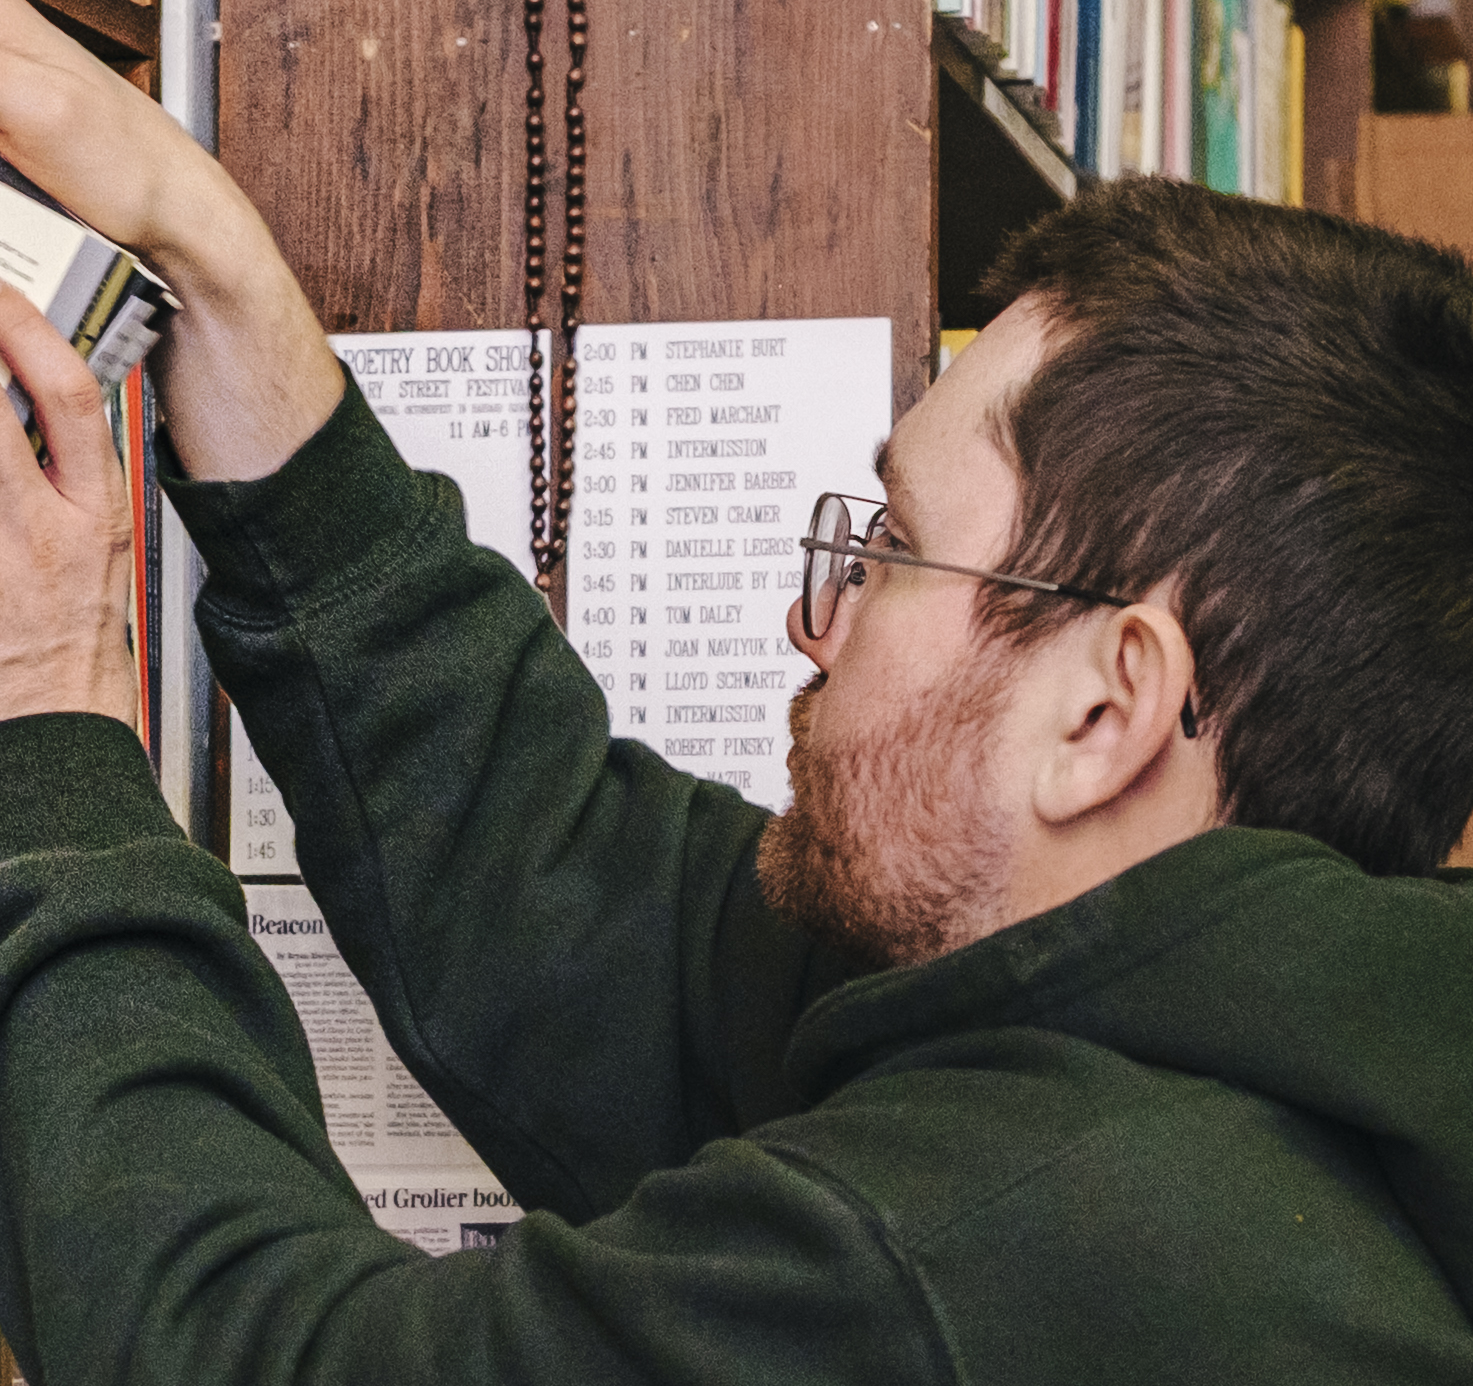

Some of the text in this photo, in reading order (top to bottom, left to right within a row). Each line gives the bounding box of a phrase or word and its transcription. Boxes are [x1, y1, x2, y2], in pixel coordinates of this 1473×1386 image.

[426, 346, 474, 373] BOOK
[584, 338, 787, 361] 2:00 PM STEPHANIE BURT
[398, 380, 451, 399] STREET
[584, 373, 745, 394] 2:15 PM CHEN CHEN
[584, 405, 781, 427] 2:30 PM FRED MARCHANT
[584, 439, 767, 460] 2:45 PM INTERMISSION
[584, 471, 797, 493] 3:00 PM JENNIFER BARBER
[584, 505, 781, 526] 3:15 PM STEVEN CRAMER
[584, 538, 794, 559] 3:30 PM DANIELLE LEGROS
[583, 574, 616, 592] 3:45
[630, 574, 647, 591] PM
[667, 572, 743, 591] INTERLUDE
[751, 572, 768, 590] BY
[582, 605, 742, 626] 4:00 PM TOM DALEY
[582, 638, 767, 658] 4:15 PM JOAN NAVIYUK
[630, 671, 786, 691] PM LLOYD SCHWARTZ
[630, 705, 766, 724] PM INTERMISSION
[665, 737, 775, 756] ROBERT PINSKY
[246, 842, 276, 860] 1:45
[393, 1188, 468, 1209] Grolier
